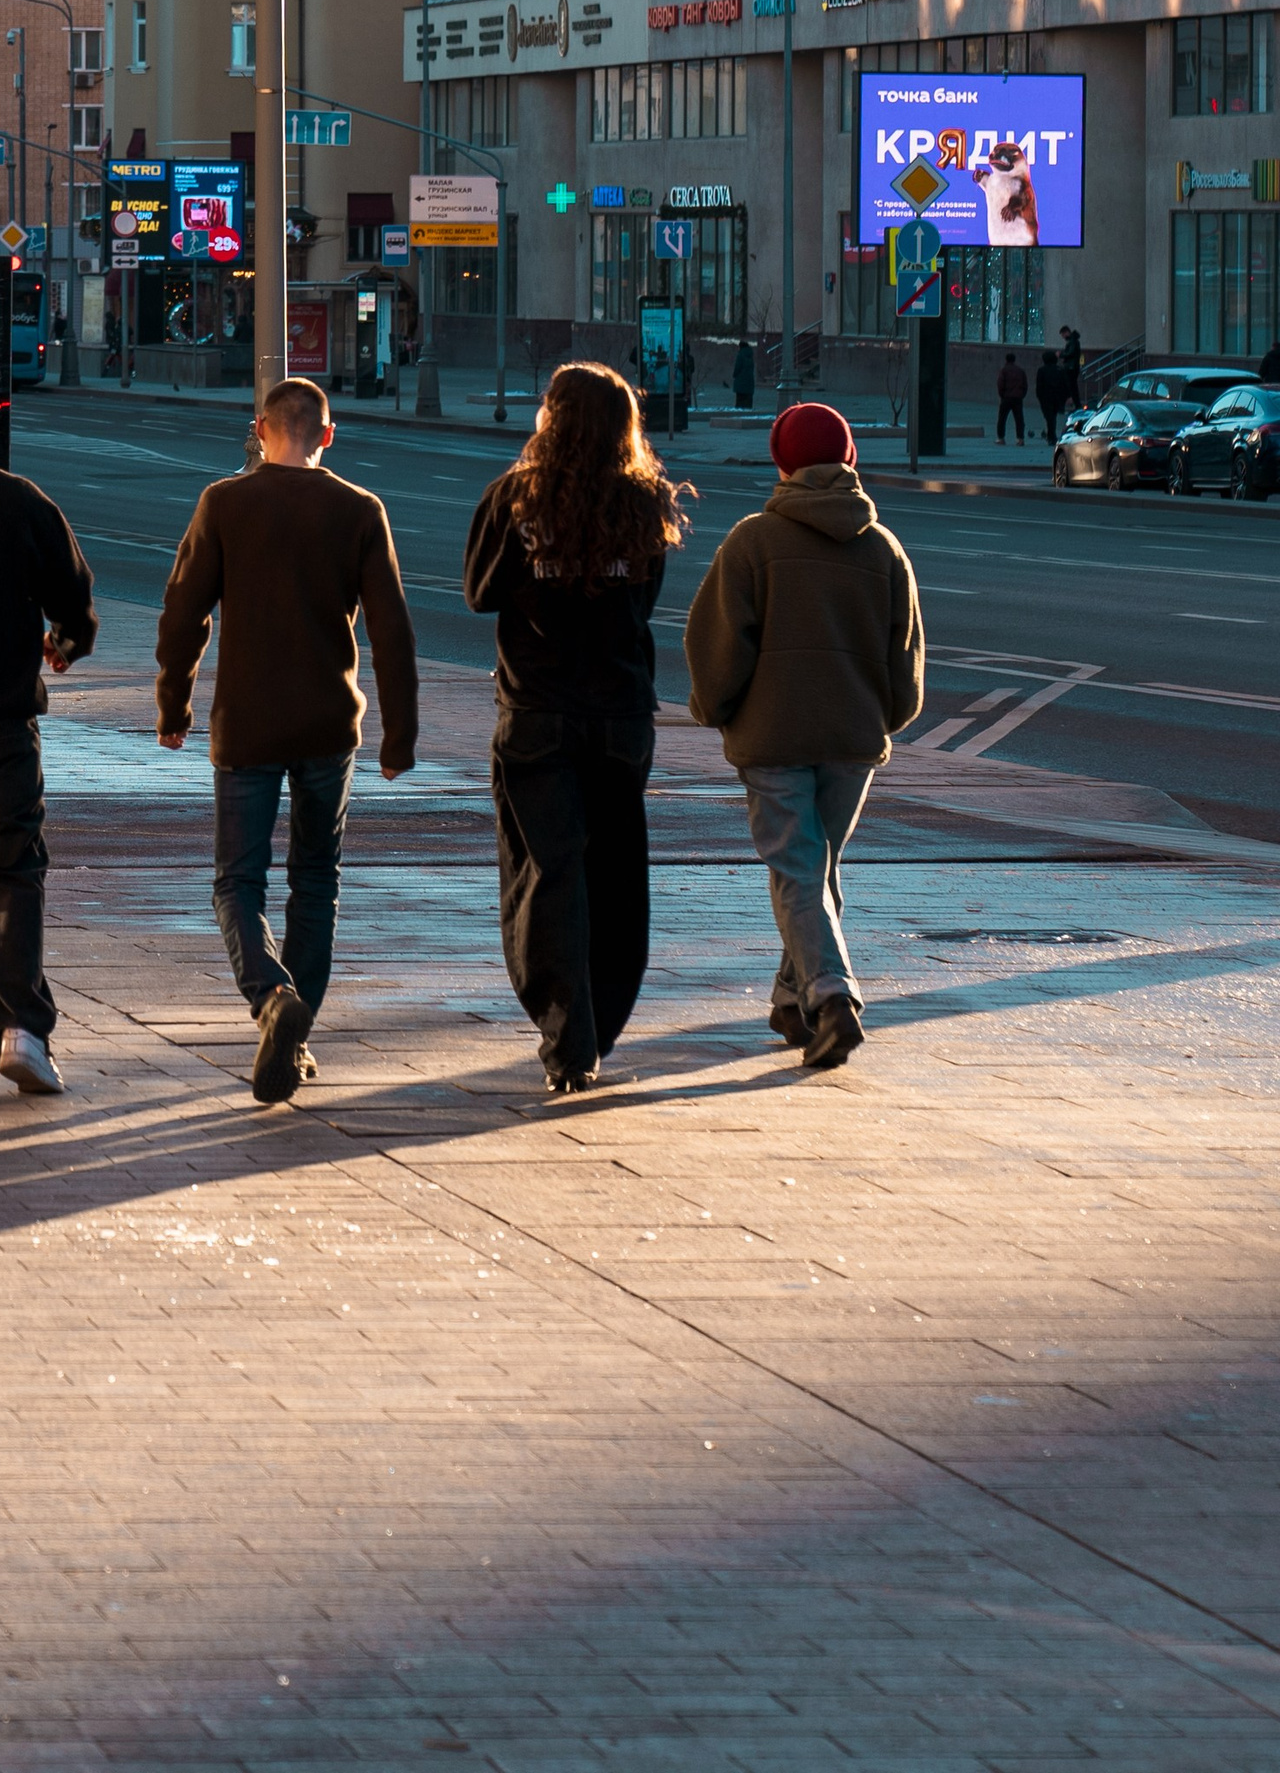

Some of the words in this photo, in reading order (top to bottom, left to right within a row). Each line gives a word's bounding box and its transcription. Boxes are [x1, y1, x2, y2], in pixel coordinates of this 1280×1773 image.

[878, 90, 930, 103] точка
[934, 88, 978, 103] банк
[112, 165, 161, 176] METRO
[593, 185, 625, 208] АПТЕКА
[670, 186, 700, 207] CERCA
[700, 185, 732, 207] TROVA
[936, 201, 977, 209] условиями
[883, 209, 913, 217] заботой
[945, 210, 976, 218] бизнесе
